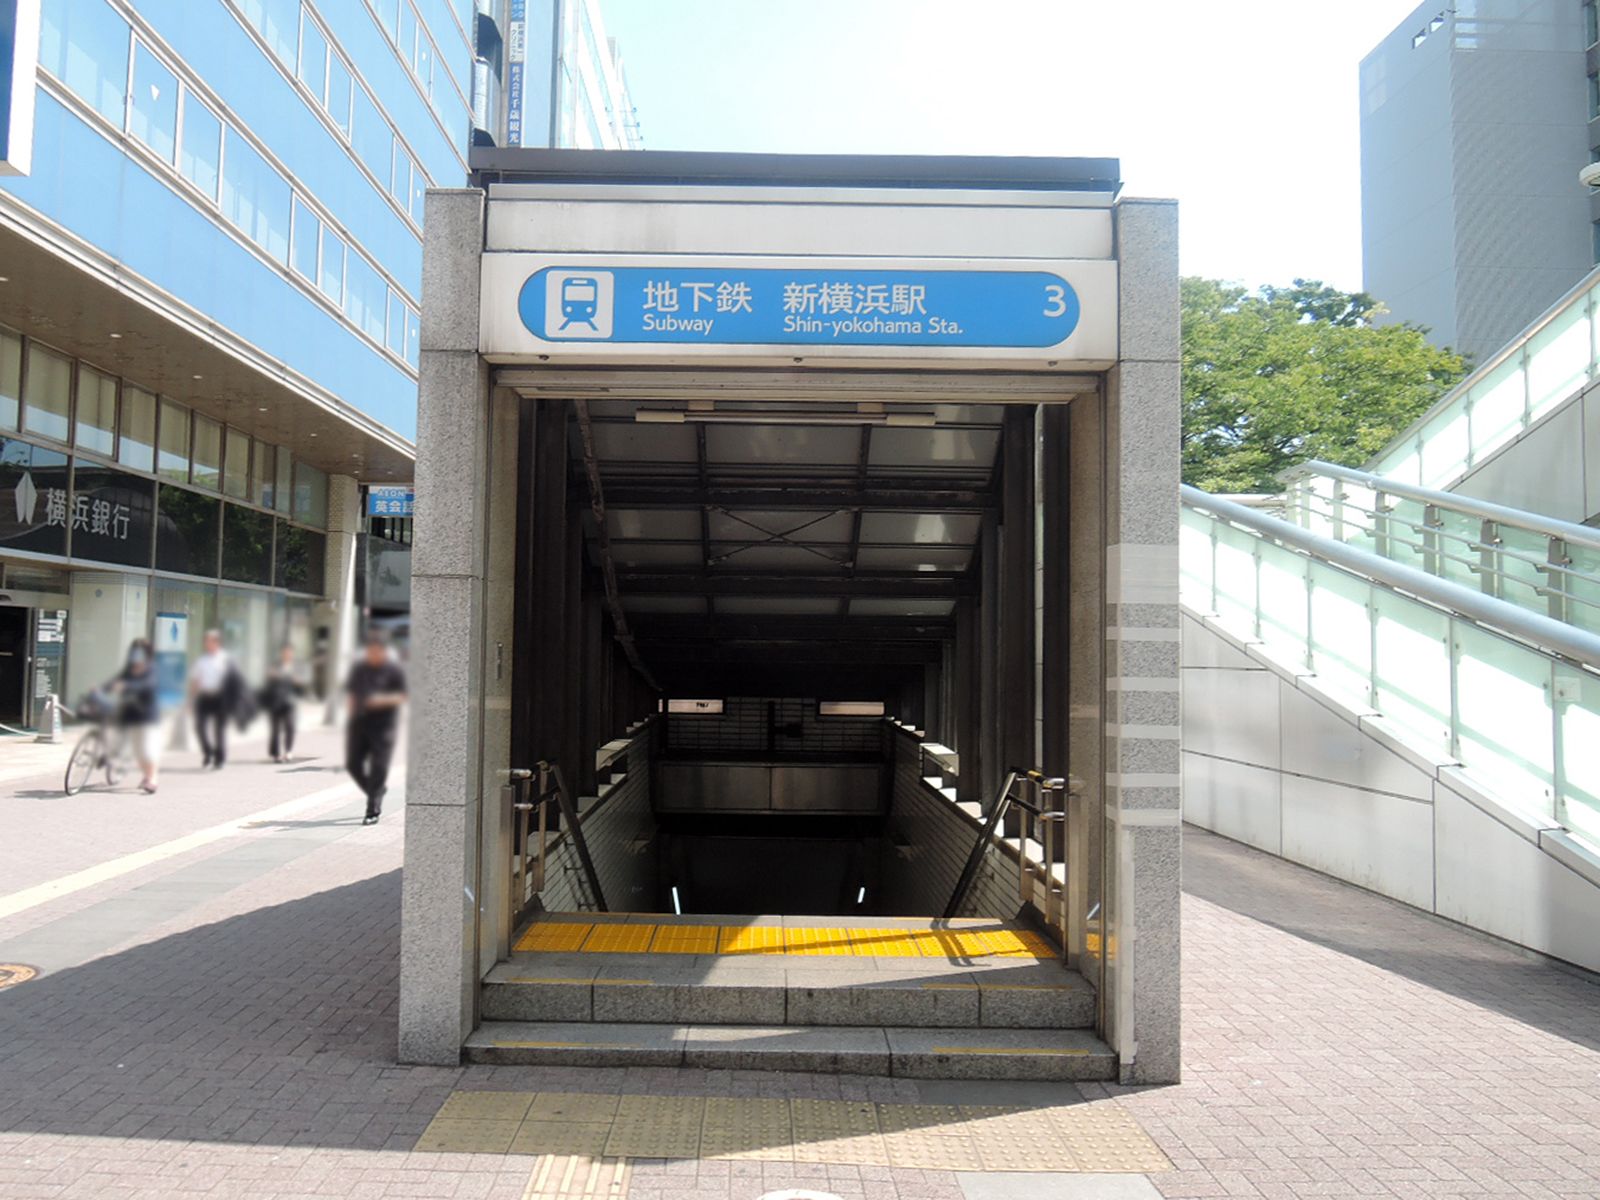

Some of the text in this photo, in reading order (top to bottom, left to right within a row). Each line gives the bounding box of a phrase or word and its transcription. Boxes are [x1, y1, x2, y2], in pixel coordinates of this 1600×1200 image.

[642, 280, 927, 315] 地下鉄 新横浜駅
[1043, 285, 1067, 317] 3
[642, 313, 964, 337] Subway Shin-yokohama Sta.
[45, 487, 130, 540] 横浜銀行
